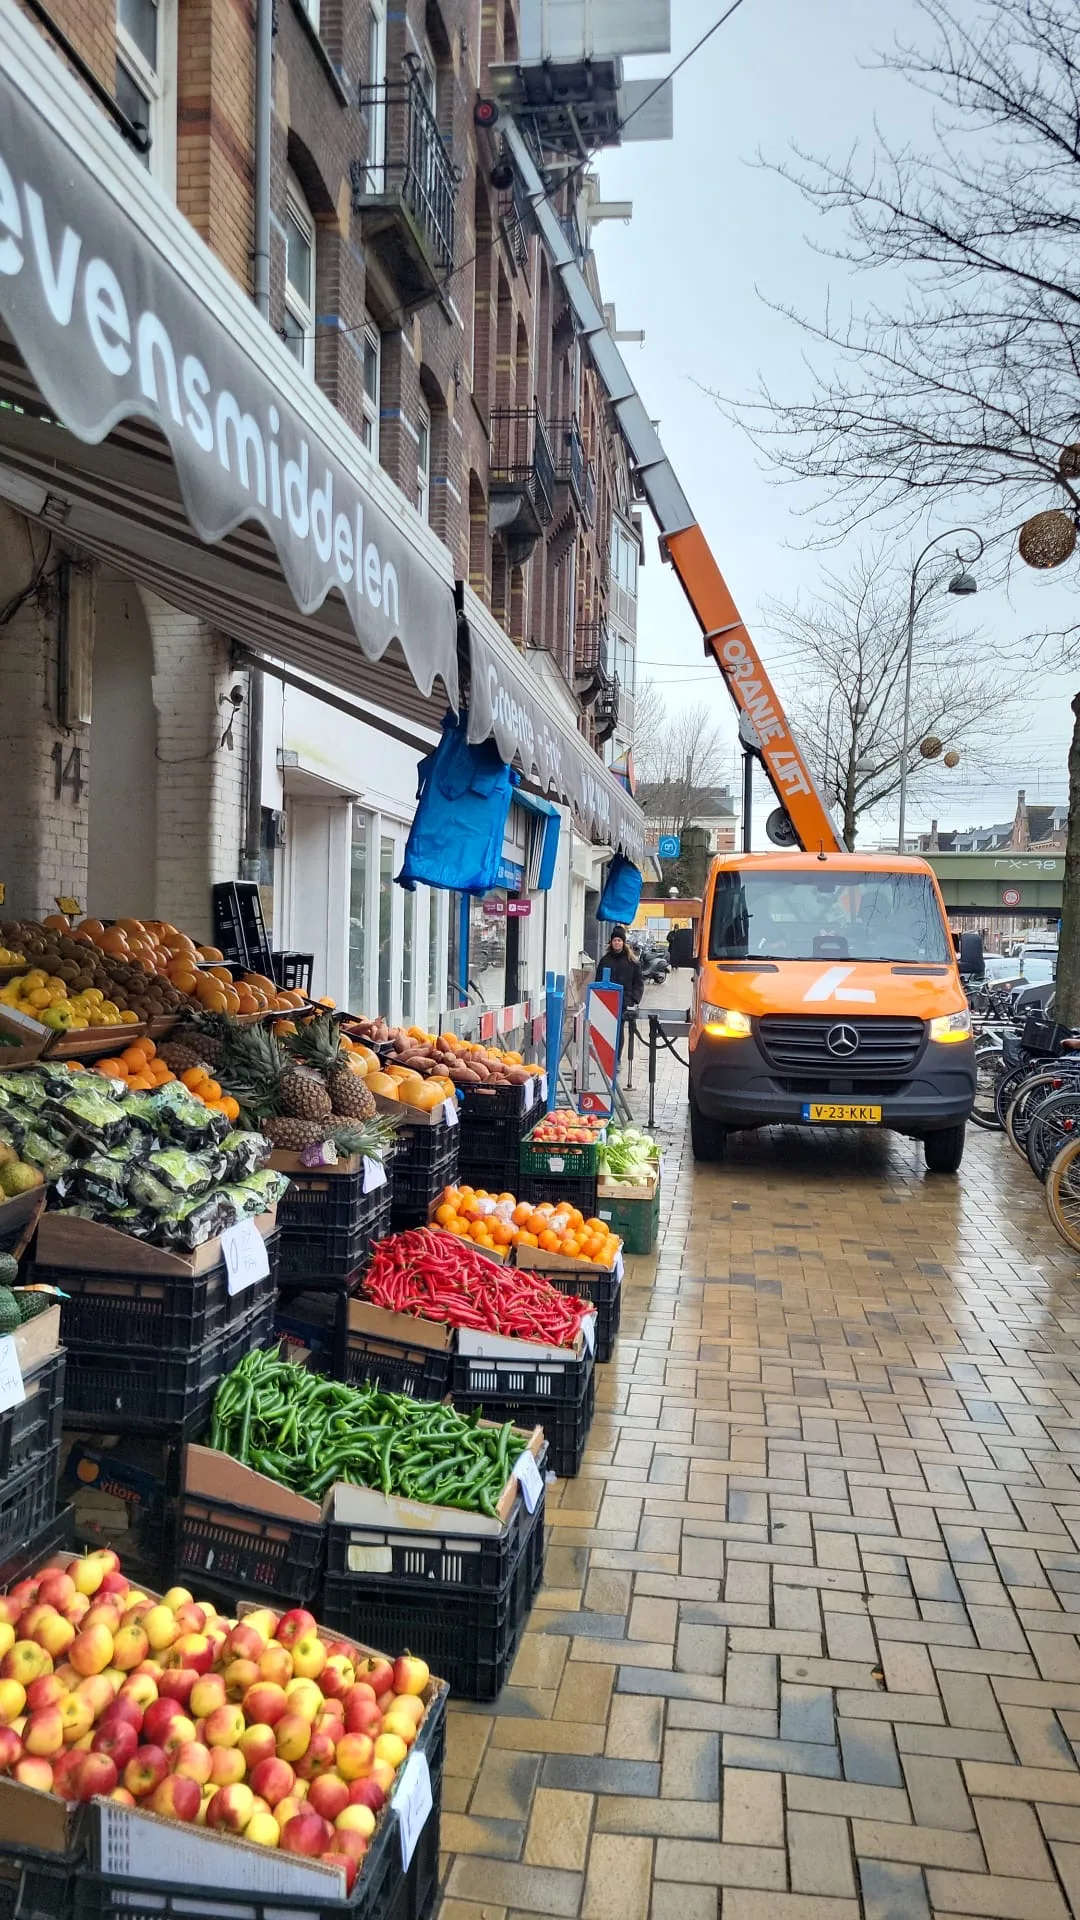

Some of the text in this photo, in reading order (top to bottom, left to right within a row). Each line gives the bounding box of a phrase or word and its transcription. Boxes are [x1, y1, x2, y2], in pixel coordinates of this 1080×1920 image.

[723, 639, 811, 796] ORANJE LIFT
[51, 742, 83, 803] 14
[815, 1106, 877, 1120] V-23-KKL
